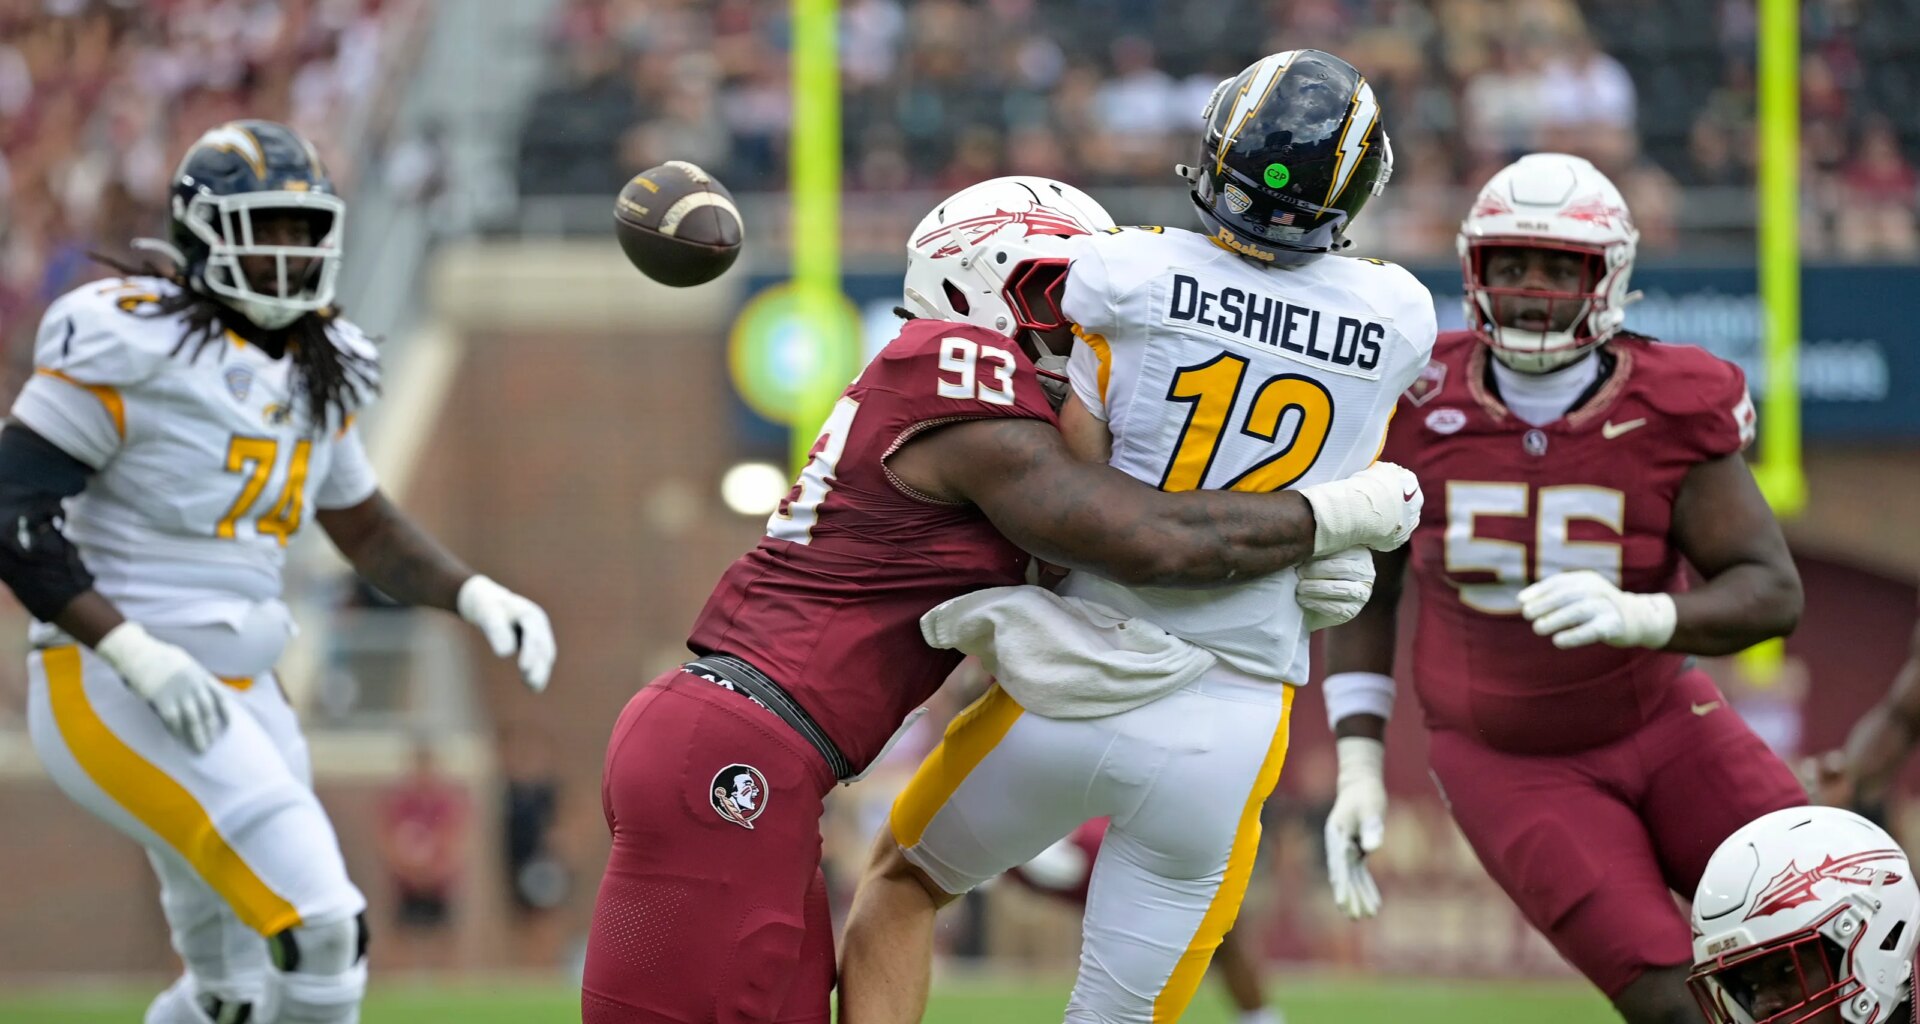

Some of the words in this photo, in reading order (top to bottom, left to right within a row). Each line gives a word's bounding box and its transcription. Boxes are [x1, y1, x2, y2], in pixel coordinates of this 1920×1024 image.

[1267, 168, 1287, 181] C2P
[937, 337, 1016, 406] 93
[1158, 350, 1334, 493] 12
[216, 434, 313, 549] 74
[1445, 479, 1624, 614] 56
